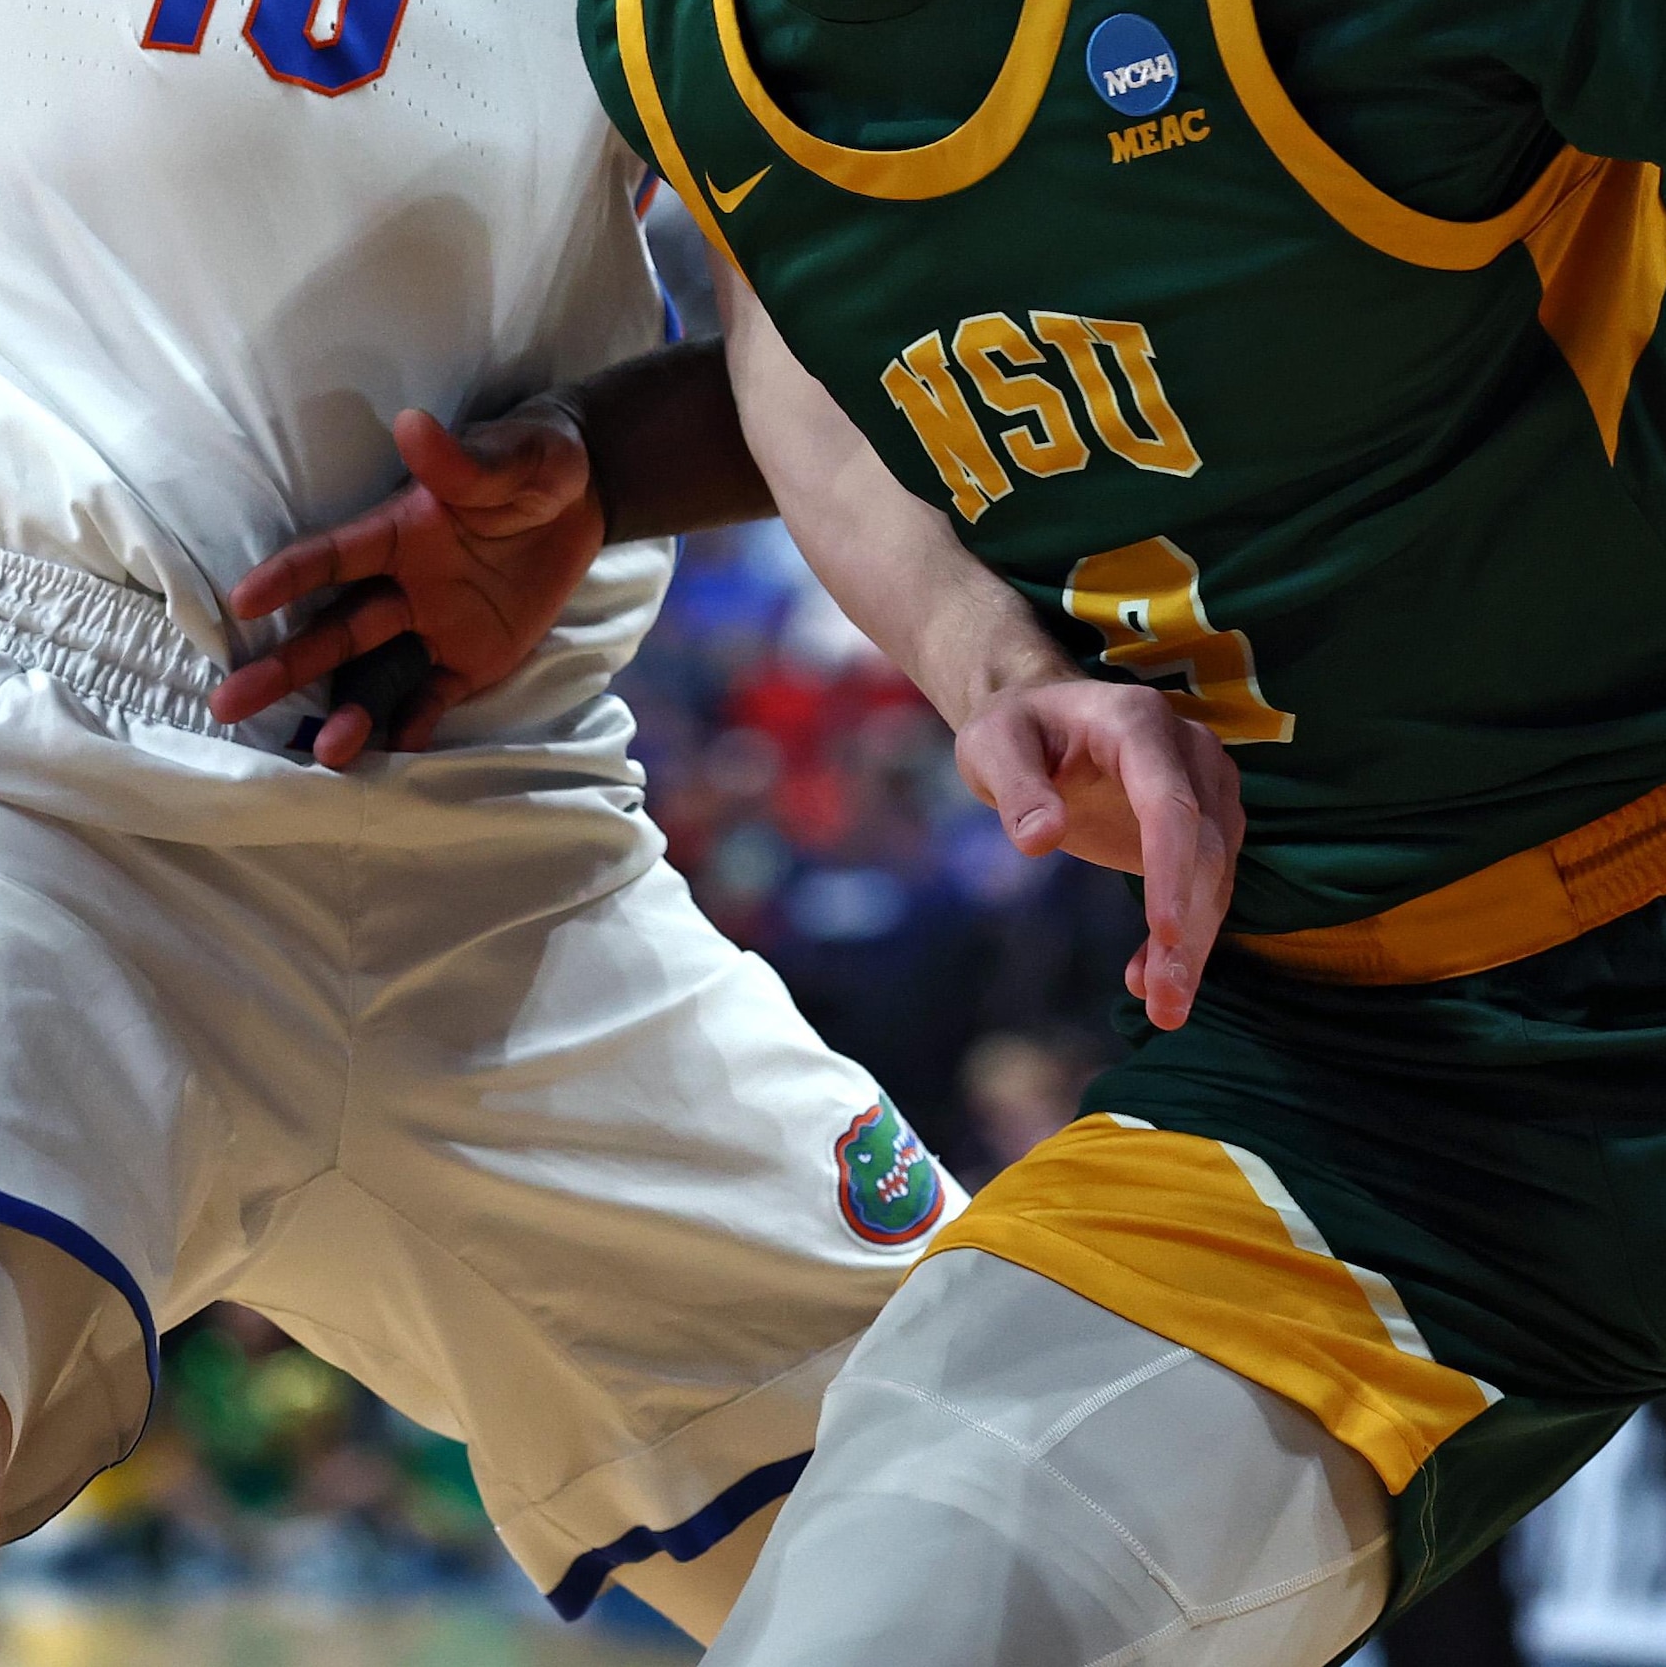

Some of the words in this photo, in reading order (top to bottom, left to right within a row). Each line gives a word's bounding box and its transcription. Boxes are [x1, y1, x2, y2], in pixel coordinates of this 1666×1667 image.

[1102, 53, 1176, 98] NCAA
[1107, 108, 1211, 164] MEAC
[880, 309, 1203, 525] NSU
